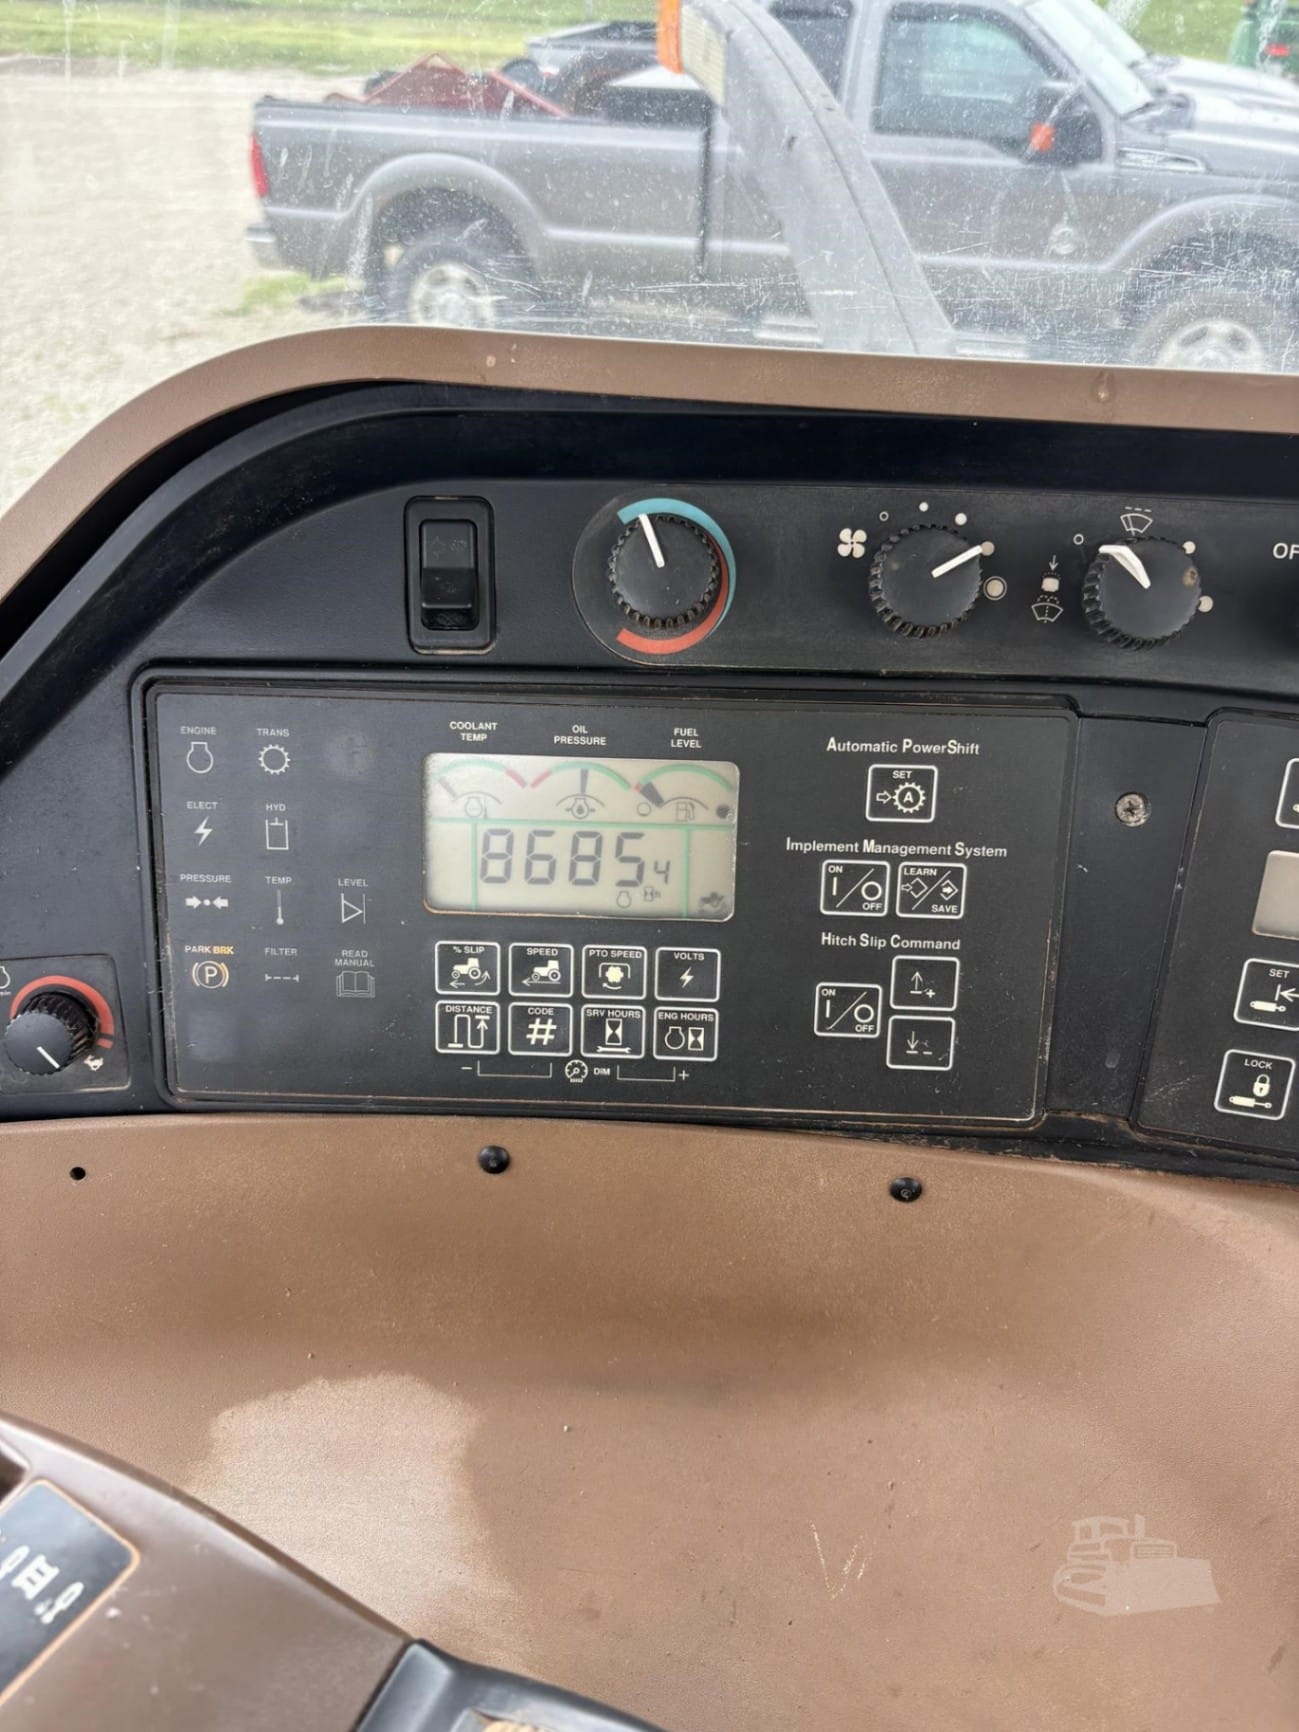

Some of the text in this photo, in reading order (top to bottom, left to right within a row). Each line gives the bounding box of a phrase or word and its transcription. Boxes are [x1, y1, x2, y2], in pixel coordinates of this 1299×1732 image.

[180, 726, 217, 736] ENGINE
[449, 721, 498, 731] COOLANT
[572, 724, 588, 734] OIL
[256, 728, 290, 738] TRANS
[460, 732, 488, 742] TEMP
[673, 727, 699, 737] FUEL
[553, 735, 607, 746] PRESSURE
[670, 739, 702, 749] LEVEL
[826, 737, 980, 755] Automatic PowerShift
[892, 770, 912, 779] SET
[186, 801, 218, 810] ELECT
[265, 803, 286, 812] HYD
[786, 836, 1008, 860] Implement Management System
[828, 865, 843, 874] ON
[903, 867, 937, 877] LEARN
[179, 873, 232, 883] PRESSURE
[265, 876, 292, 885] TEMP
[337, 878, 369, 888] LEVEL
[862, 902, 883, 911] OFF
[931, 904, 958, 914] SAVE
[821, 932, 961, 950] Hitch Slip Command
[184, 945, 235, 955] PARK BRK
[264, 947, 298, 957] FILTER
[341, 949, 369, 958] READ
[464, 945, 485, 955] SLIP
[526, 947, 559, 957] SPEED
[589, 949, 643, 960] PTO SPEED
[673, 952, 705, 961] VOLTS
[334, 958, 375, 968] MANUAL
[1268, 968, 1290, 979] SET
[821, 988, 836, 997] ON
[445, 1005, 493, 1014] DISTANCE
[527, 1006, 555, 1016] CODE
[586, 1009, 641, 1019] SRV HOURS
[658, 1012, 714, 1023] ENG HOURS
[855, 1024, 875, 1033] OFF
[1243, 1058, 1273, 1070] LOCK
[593, 1067, 611, 1076] DIM
